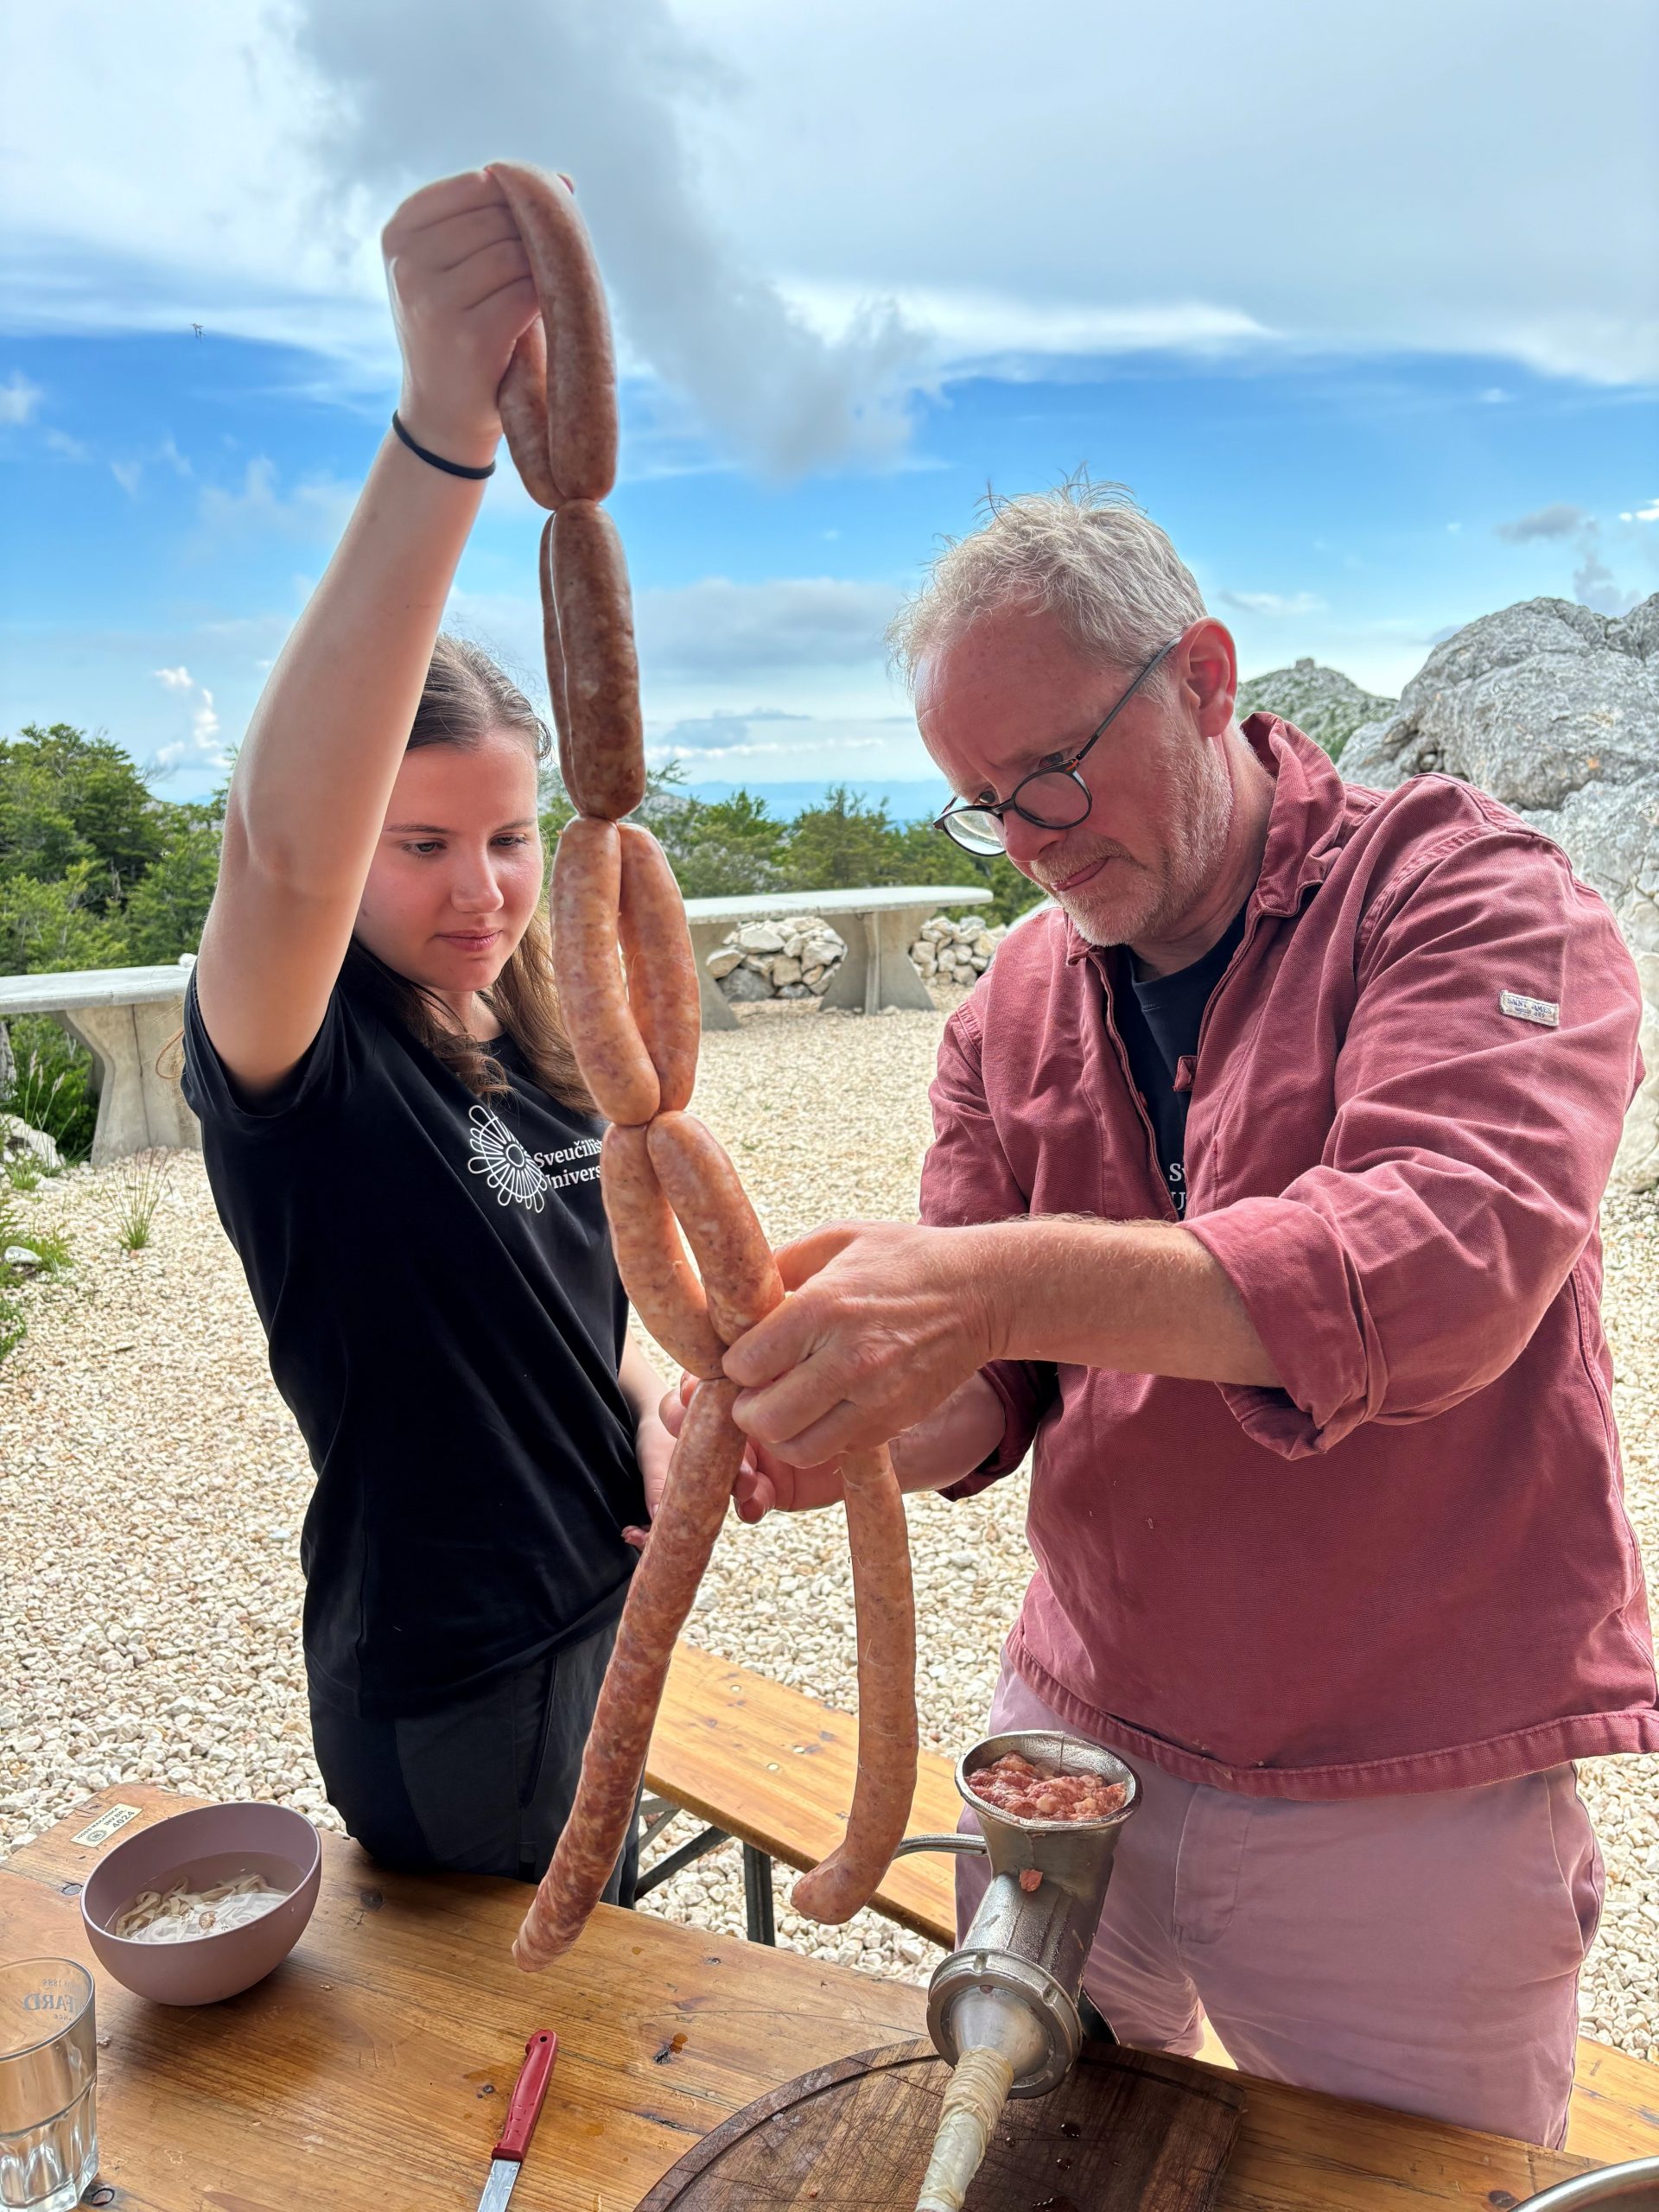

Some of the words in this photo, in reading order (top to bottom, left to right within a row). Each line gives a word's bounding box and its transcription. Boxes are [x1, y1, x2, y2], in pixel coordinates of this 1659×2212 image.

[1169, 1162, 1185, 1182] S
[1171, 1192, 1187, 1211] U
[112, 1811, 135, 1827] 4024
